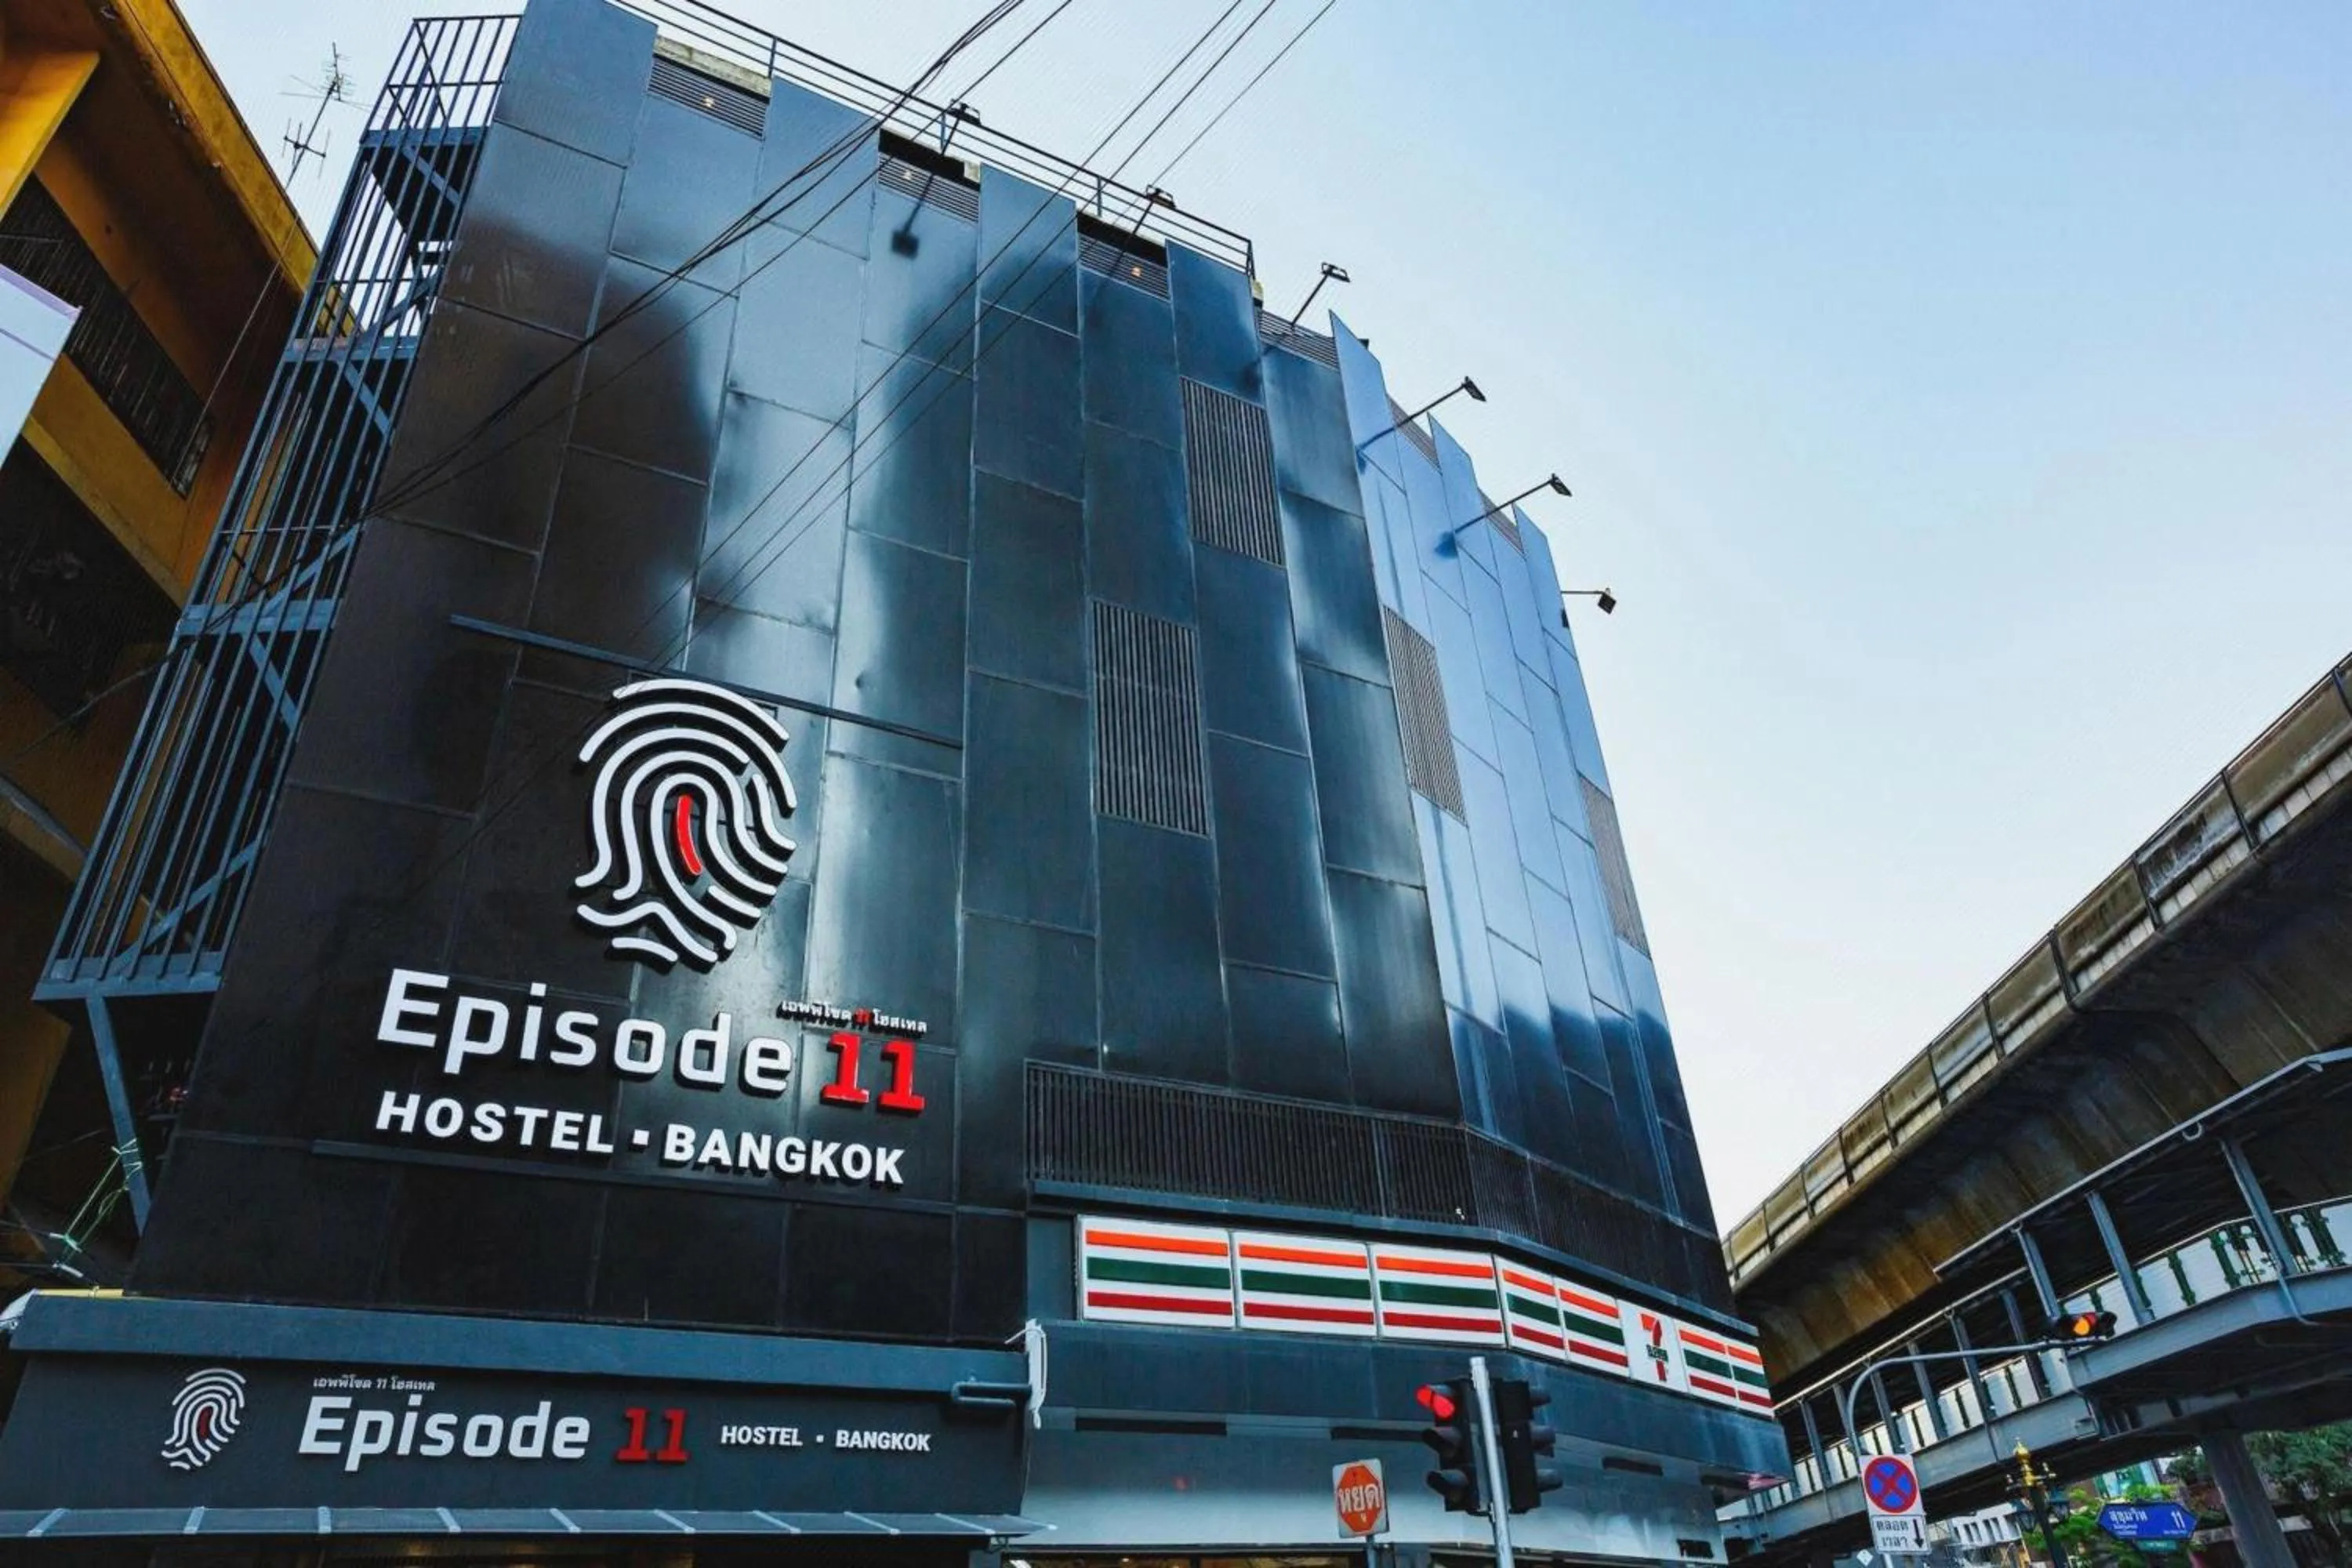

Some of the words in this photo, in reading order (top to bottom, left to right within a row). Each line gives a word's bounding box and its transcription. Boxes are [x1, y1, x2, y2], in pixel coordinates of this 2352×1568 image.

[376, 967, 792, 1091] Episode
[820, 1032, 926, 1111] 11
[376, 1091, 614, 1153] HOSTEL
[663, 1123, 905, 1184] BANGKOK
[298, 1394, 590, 1472] Episode
[615, 1408, 688, 1461] 11
[720, 1425, 804, 1446] HOSTEL
[835, 1429, 931, 1451] BANGKOK
[1338, 1483, 1381, 1523] หยุด
[2170, 1510, 2187, 1530] 11
